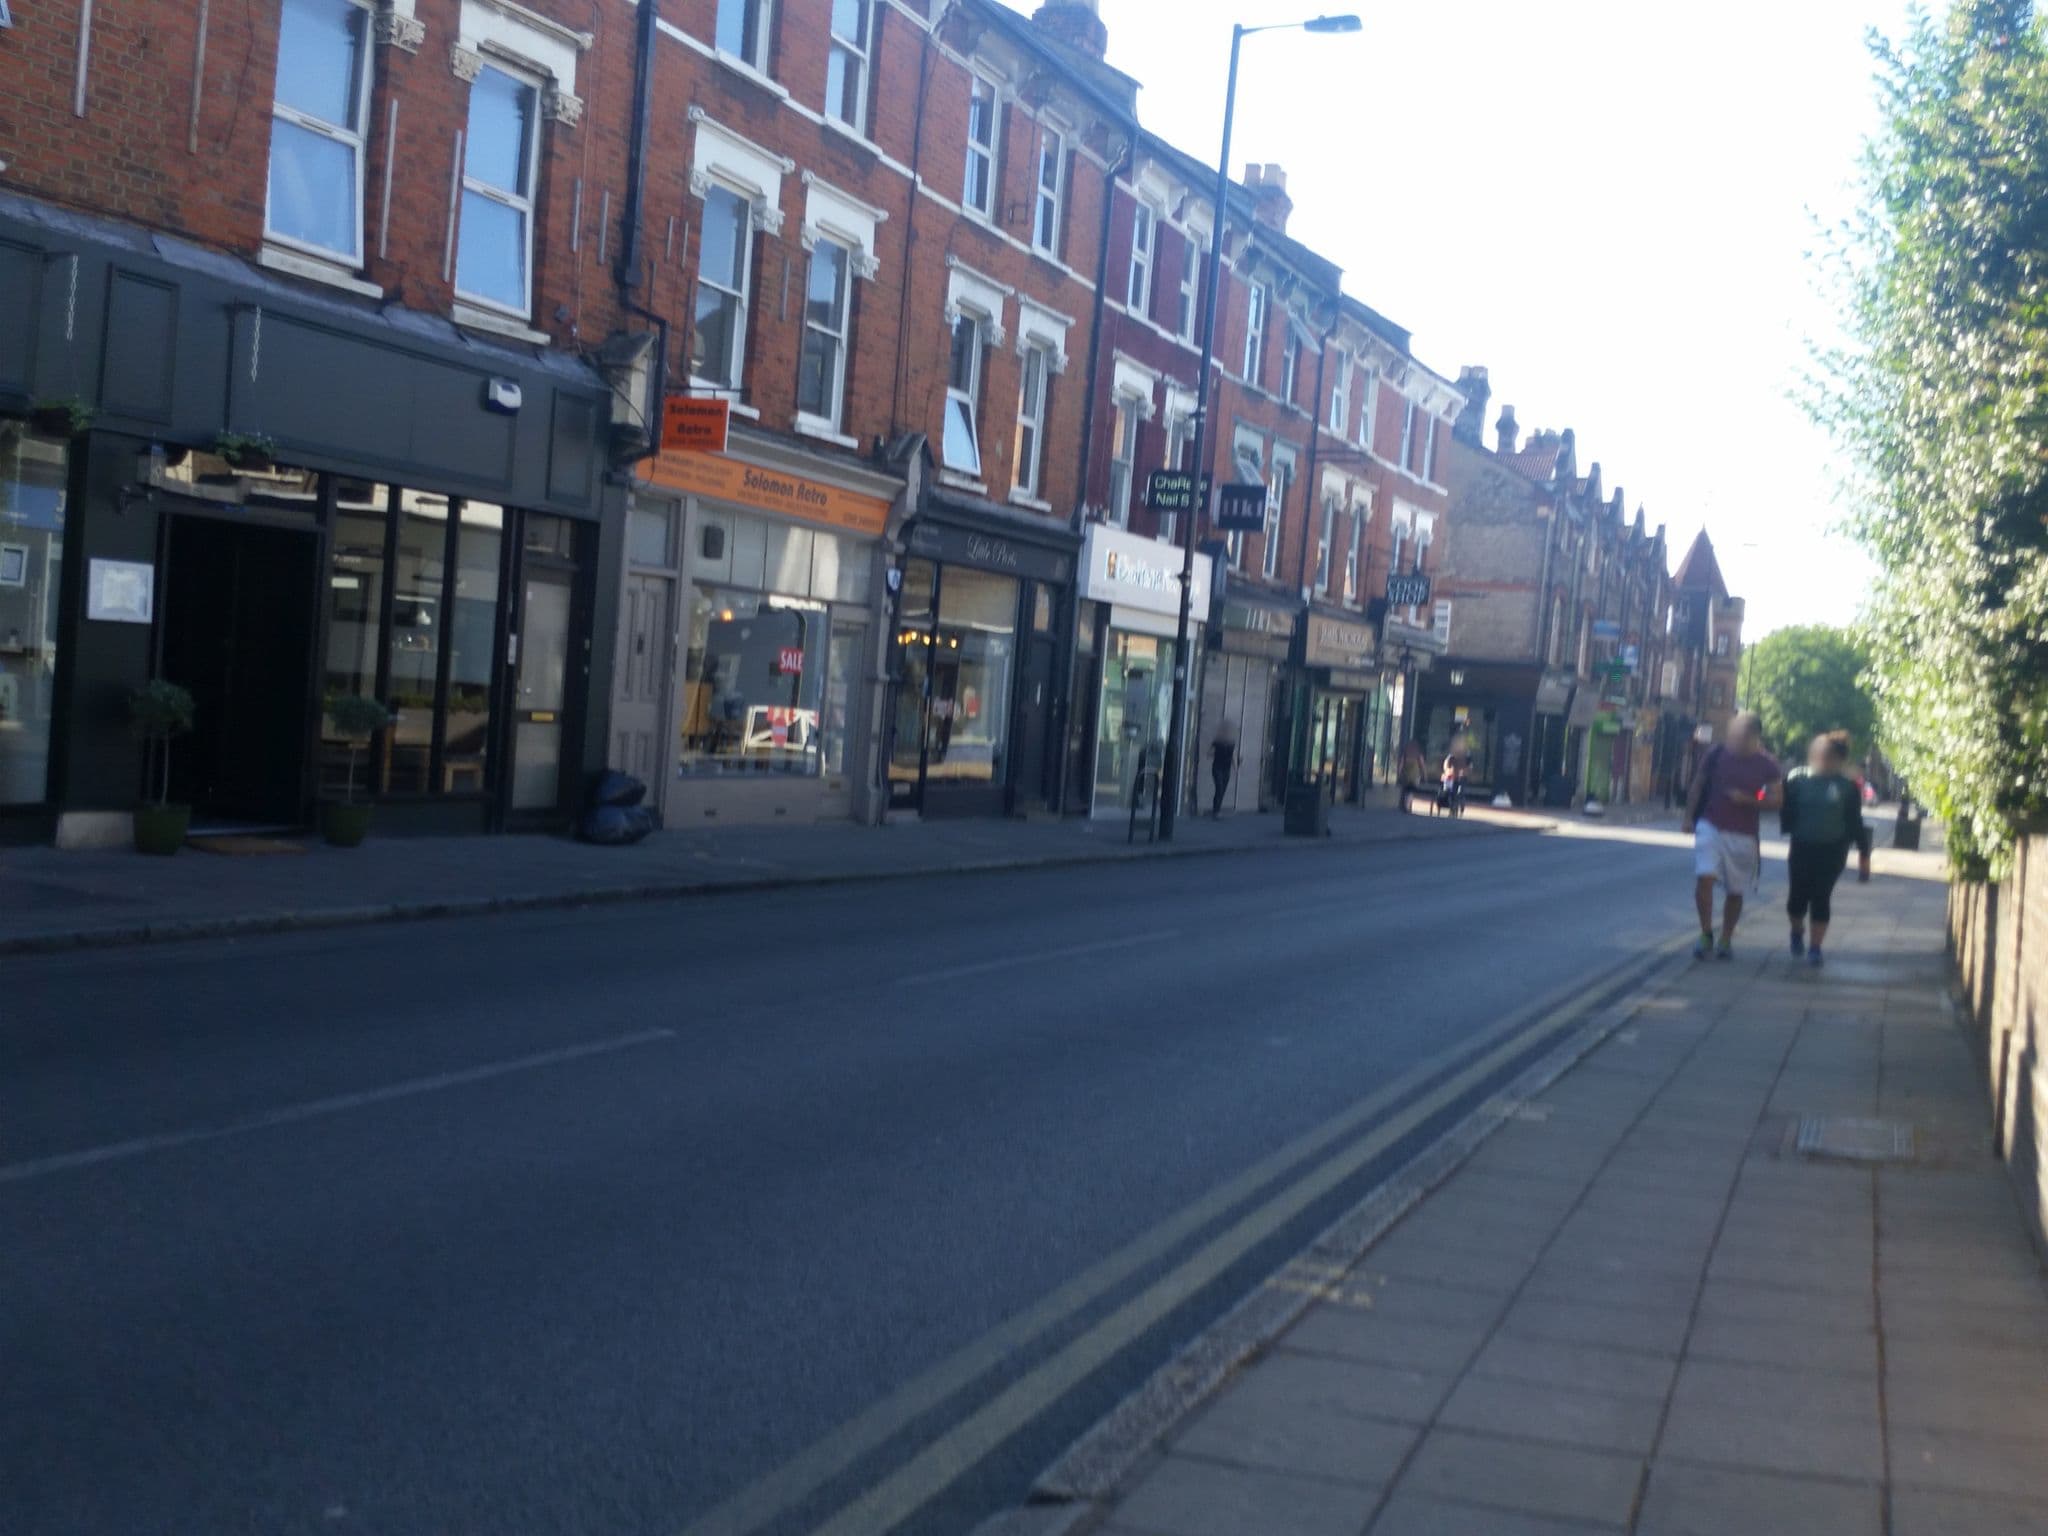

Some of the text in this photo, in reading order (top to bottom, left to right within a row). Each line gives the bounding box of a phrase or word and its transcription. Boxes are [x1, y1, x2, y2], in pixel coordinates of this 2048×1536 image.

[743, 468, 794, 497] Solomon
[796, 484, 829, 506] Retro
[1155, 492, 1178, 507] Nail
[780, 651, 803, 671] SALE
